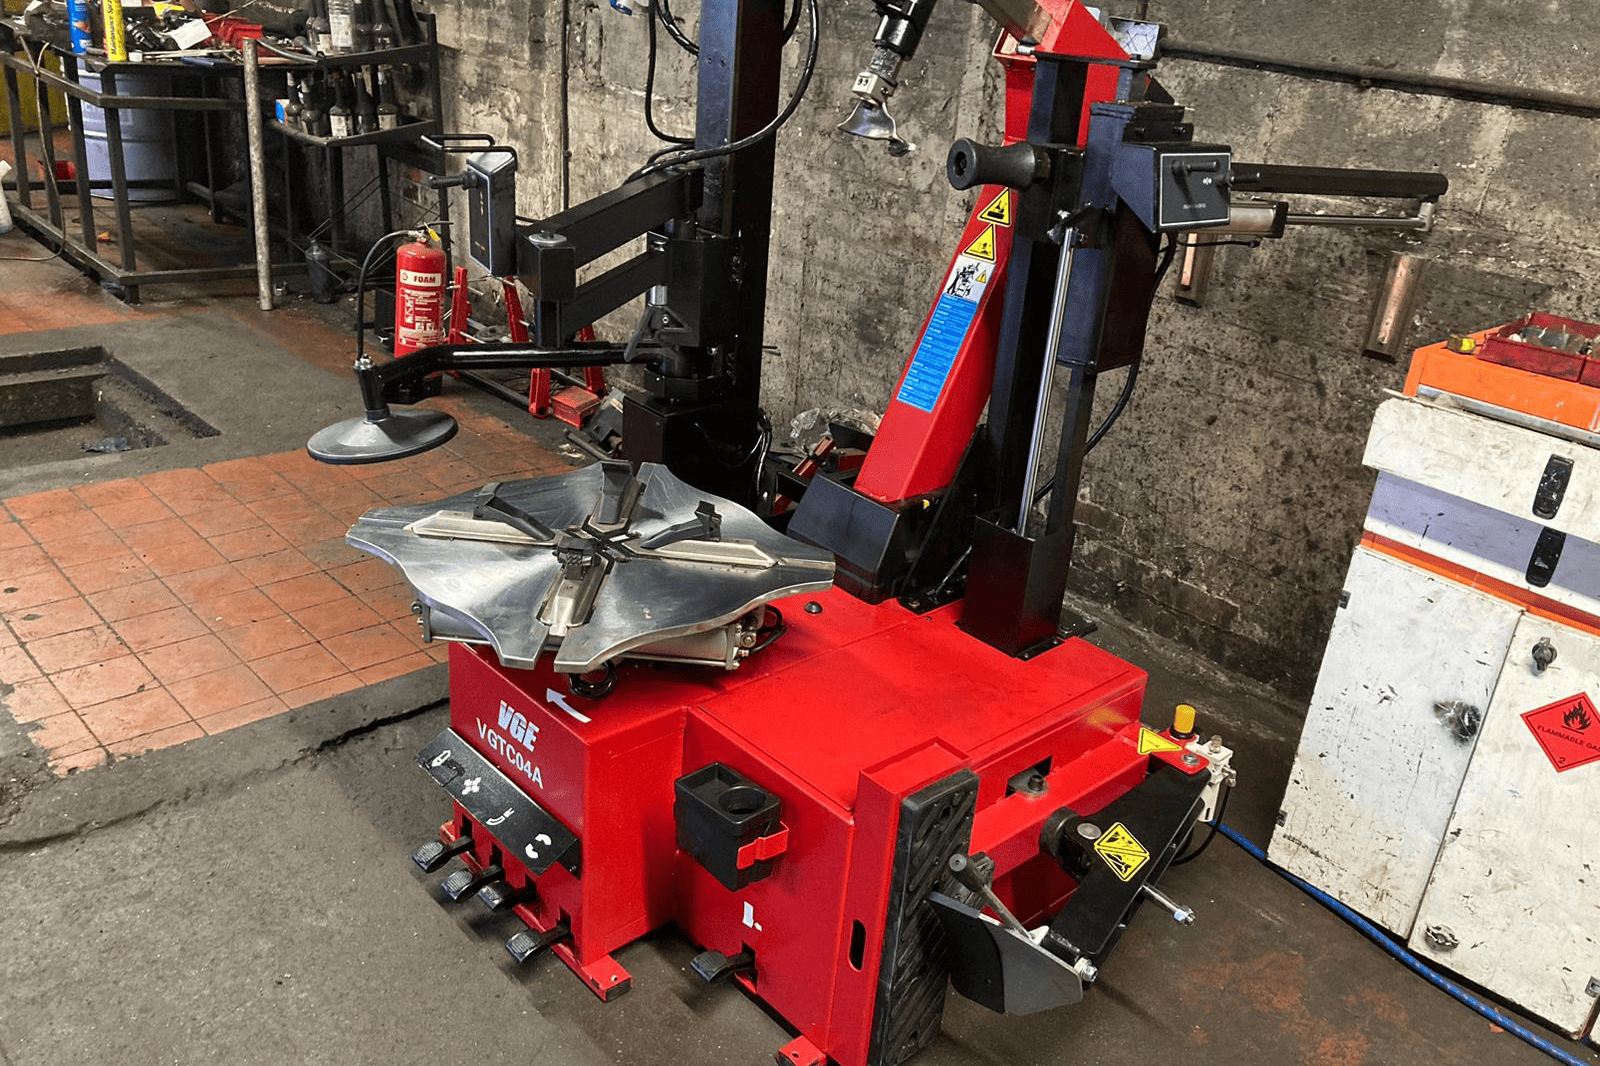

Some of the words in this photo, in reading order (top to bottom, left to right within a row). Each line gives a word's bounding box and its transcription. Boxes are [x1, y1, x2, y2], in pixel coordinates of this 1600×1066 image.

[413, 275, 436, 284] FOAM
[498, 699, 540, 753] VGE
[1537, 725, 1584, 746] FLAMMABLE
[476, 716, 544, 790] VGTC04A
[1558, 756, 1566, 765] 2
